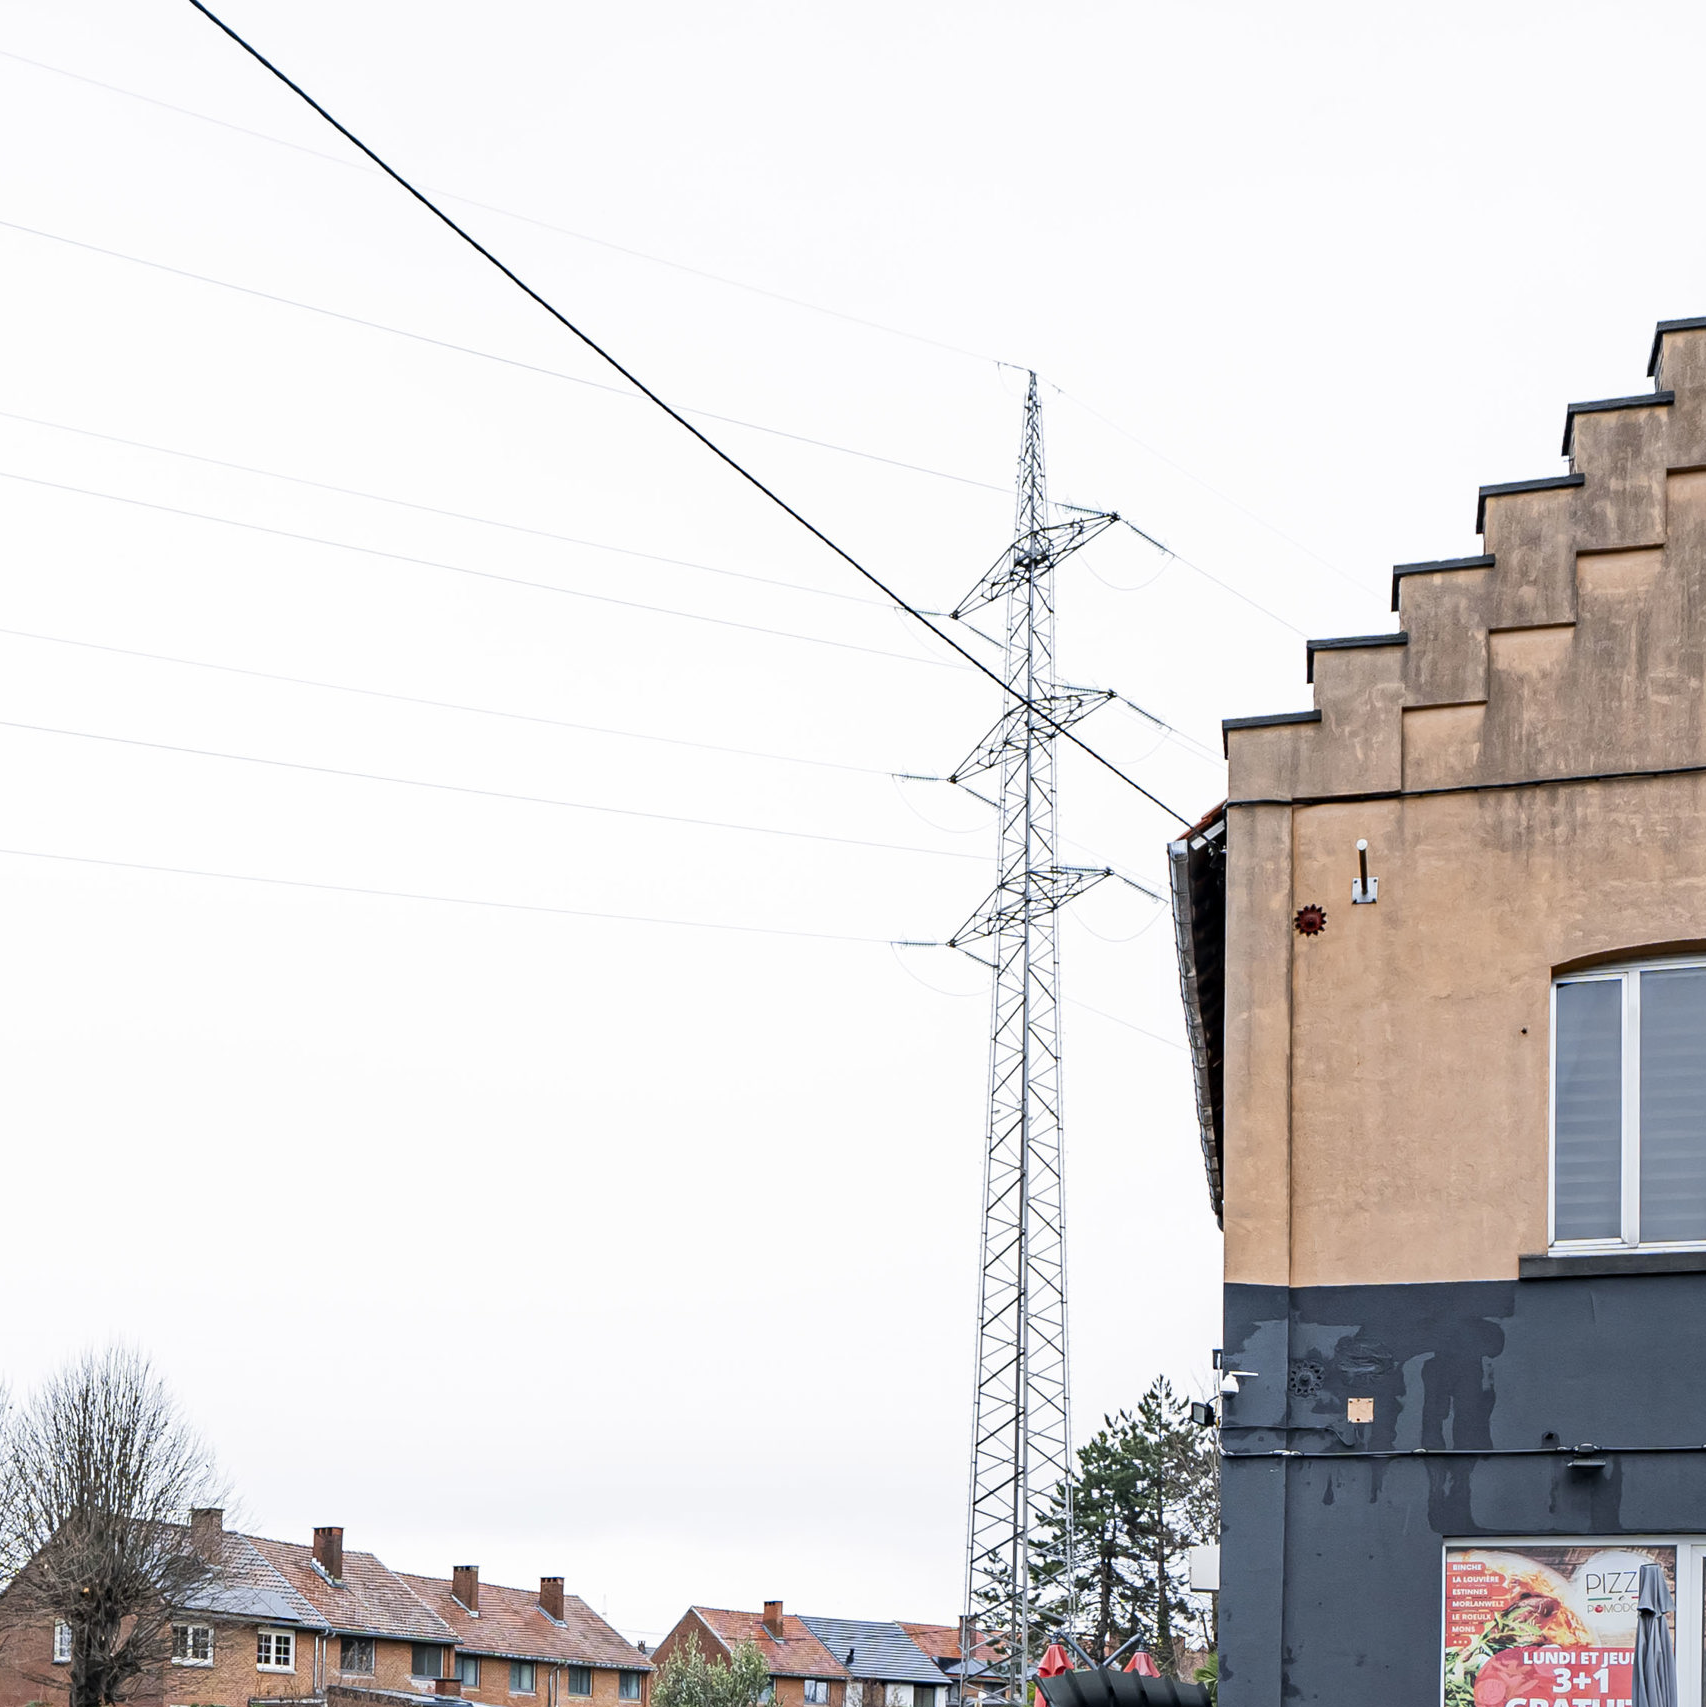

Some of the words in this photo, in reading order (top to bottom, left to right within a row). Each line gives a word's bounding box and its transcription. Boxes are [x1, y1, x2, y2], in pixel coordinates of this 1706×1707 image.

[1463, 1574, 1500, 1583] LOUVIÈRE
[1586, 1571, 1638, 1594] PIZZ
[1452, 1600, 1505, 1608] MORLANWELZ
[1587, 1602, 1638, 1614] POMODO
[1451, 1625, 1476, 1633] MONS
[1523, 1652, 1576, 1665] LUNDI
[1580, 1652, 1599, 1665] ET
[1601, 1652, 1634, 1667] JEU
[1552, 1668, 1610, 1693] 3+1
